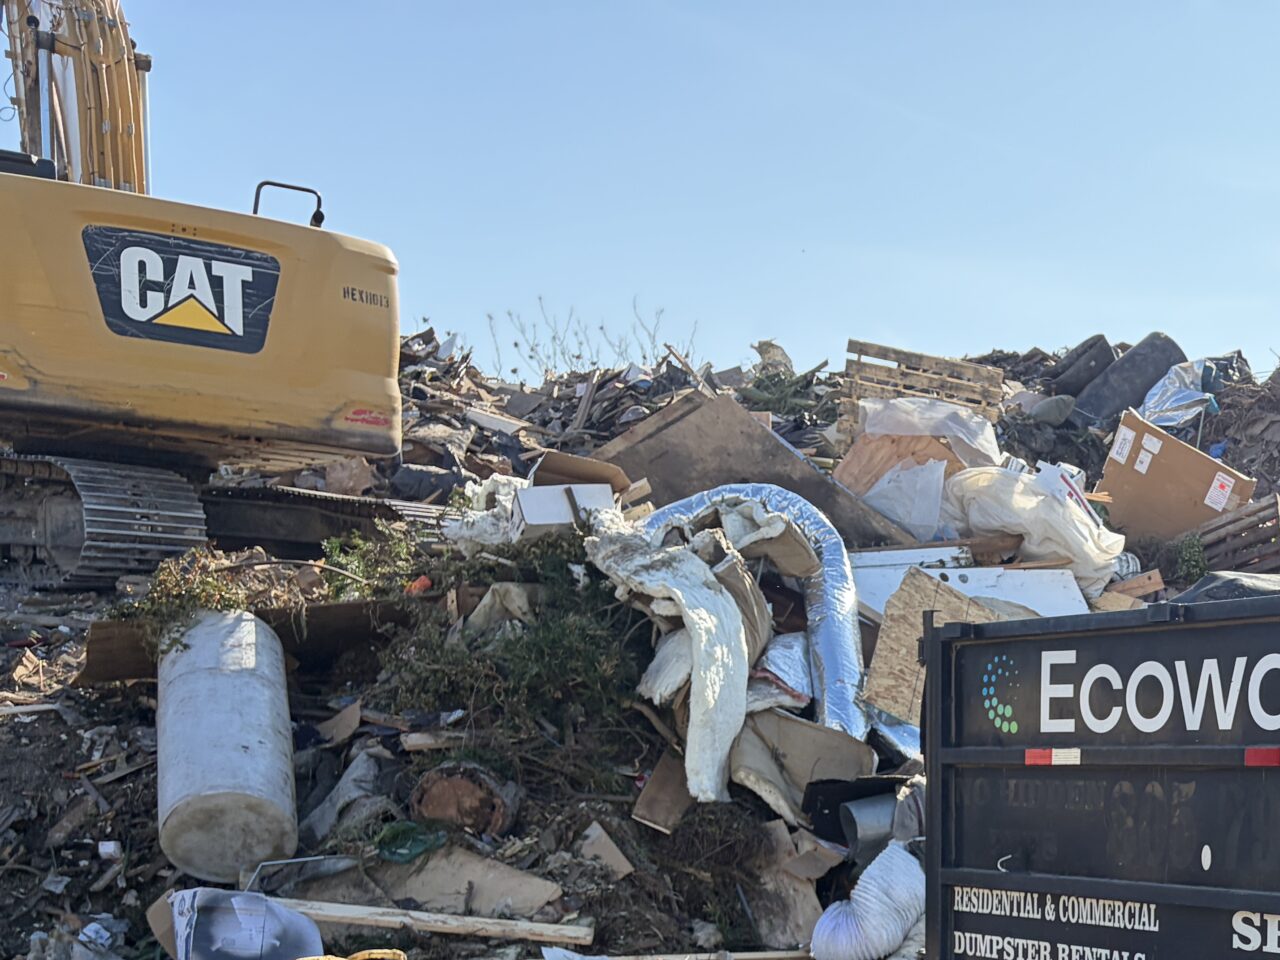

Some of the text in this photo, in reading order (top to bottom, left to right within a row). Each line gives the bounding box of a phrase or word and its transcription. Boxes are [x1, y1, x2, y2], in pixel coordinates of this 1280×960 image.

[119, 246, 253, 337] CAT
[953, 886, 1160, 932] RESIDENTIAL & COMMERCIAL
